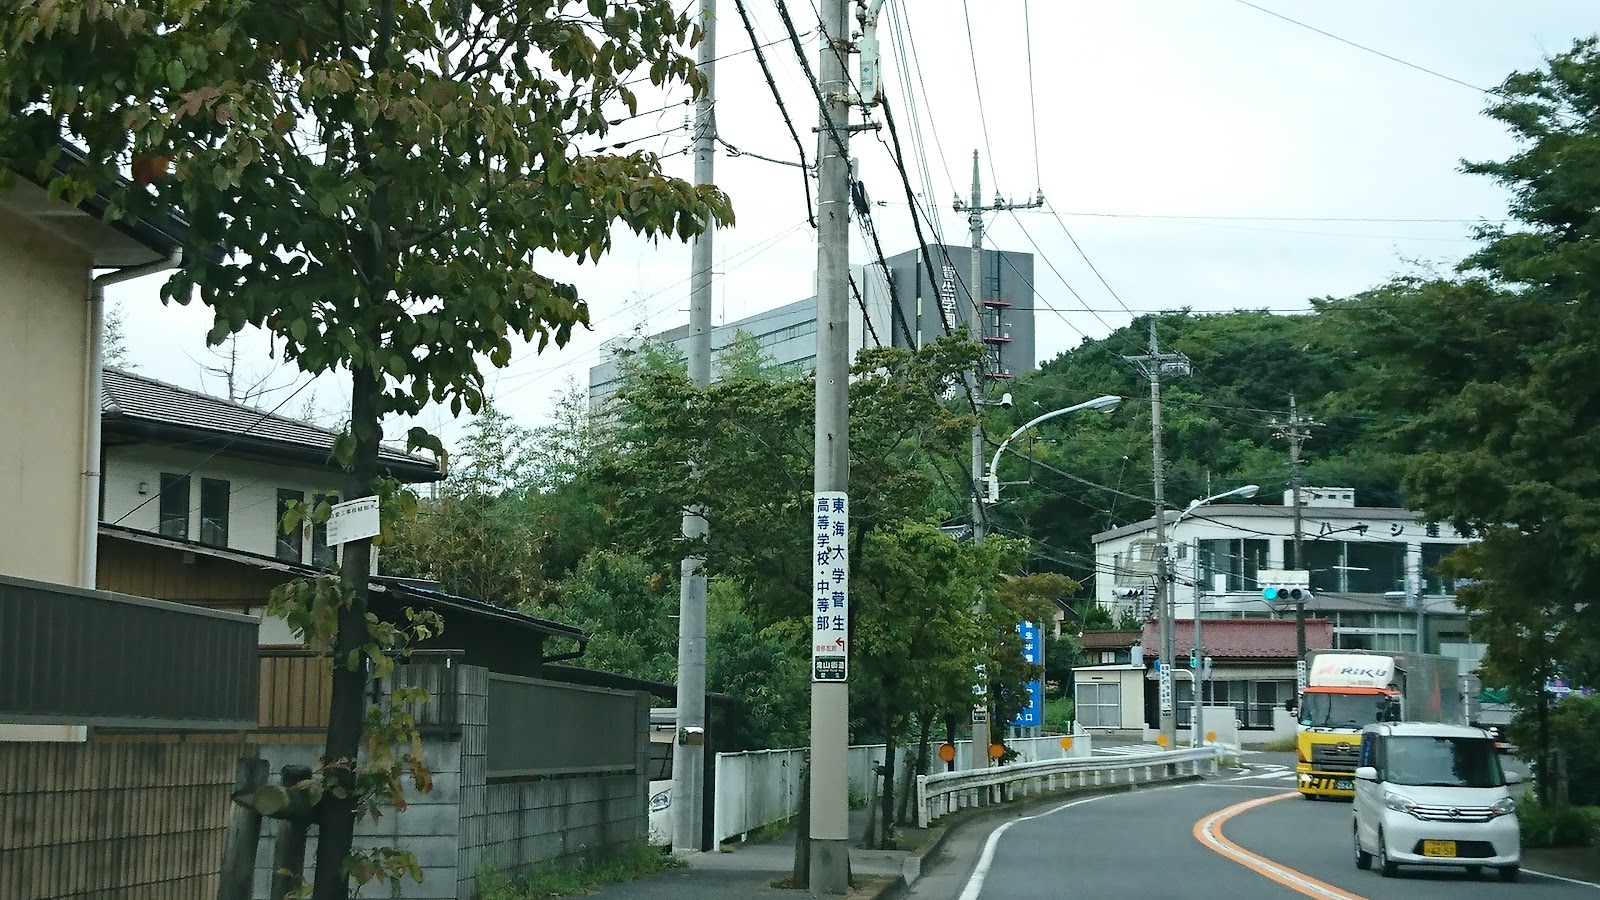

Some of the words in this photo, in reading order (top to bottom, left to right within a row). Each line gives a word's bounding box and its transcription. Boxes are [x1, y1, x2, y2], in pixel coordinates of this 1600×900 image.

[816, 497, 830, 630] 高等学校・中等部
[832, 497, 845, 630] 東海大学菅生
